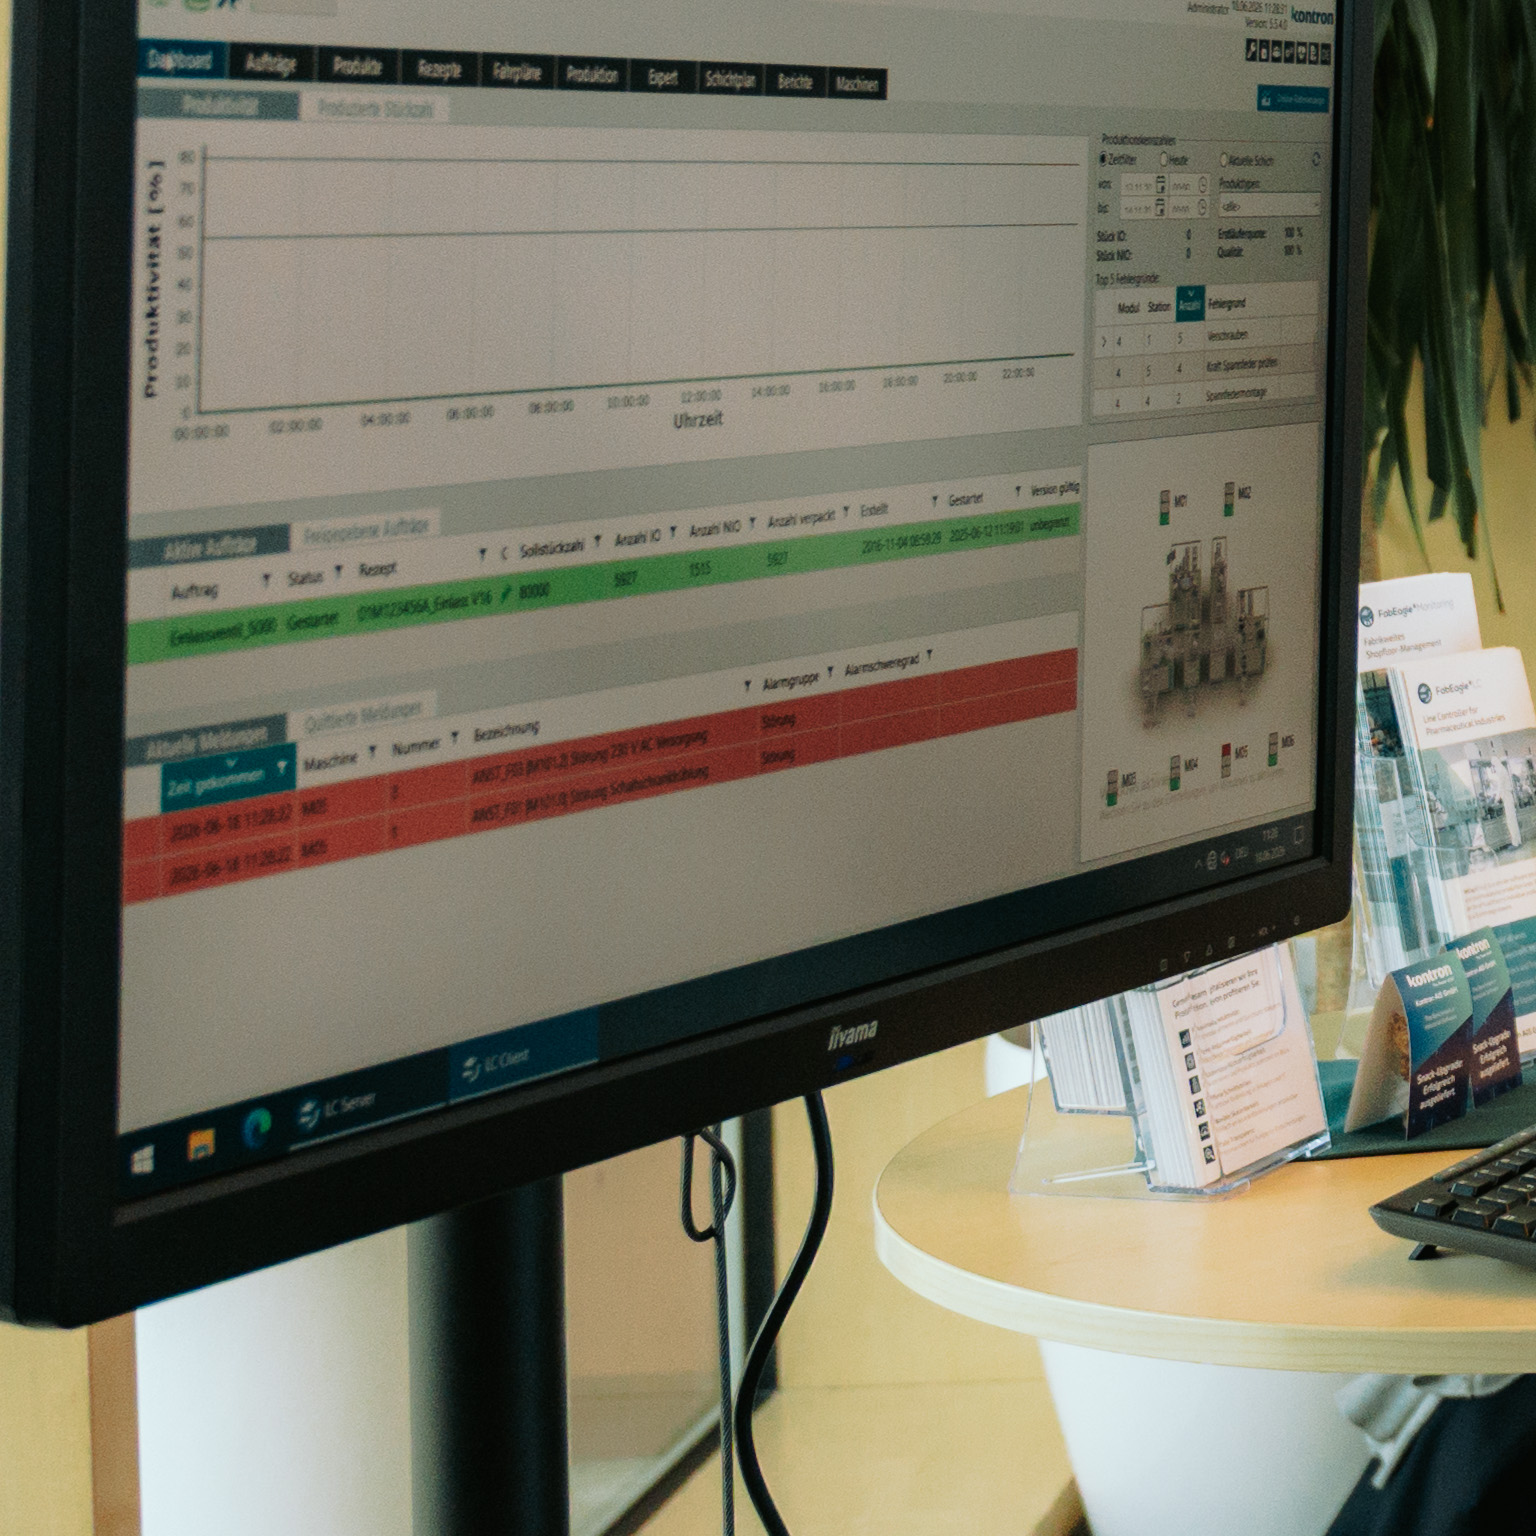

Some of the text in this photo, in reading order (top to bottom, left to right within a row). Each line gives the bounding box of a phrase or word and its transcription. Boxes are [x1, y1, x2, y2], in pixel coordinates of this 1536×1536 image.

[1291, 5, 1335, 26] kontron
[148, 49, 213, 71] Dashboard
[333, 55, 382, 76] Produkte
[418, 58, 462, 82] Rezepte
[493, 62, 543, 83] Fahrpläne
[566, 65, 619, 85] Produktion
[705, 70, 757, 92] Schichtplan
[777, 72, 813, 91] Berichte
[835, 76, 879, 94] Maschinen
[1118, 302, 1140, 314] Modul
[1148, 301, 1171, 313] Station
[673, 410, 725, 429] Uhrzeit
[767, 512, 798, 530] Anzahl
[614, 530, 647, 549] Anzahl
[689, 522, 722, 541] Anzahl
[288, 570, 324, 588] Status
[359, 561, 397, 579] Rezept
[171, 584, 219, 601] Auftrag
[1366, 639, 1442, 659] Shopfloor-Management
[1437, 708, 1468, 721] Controller
[1469, 705, 1478, 716] for
[474, 719, 540, 743] Bezeichnung
[1426, 720, 1474, 736] Pharmaceutical
[391, 738, 441, 757] Nummer
[304, 751, 358, 772] Maschine
[168, 769, 265, 798] Zeit gekommen
[1455, 938, 1491, 960] kontron
[1406, 964, 1453, 988] kontron
[827, 1019, 880, 1052] iiyama
